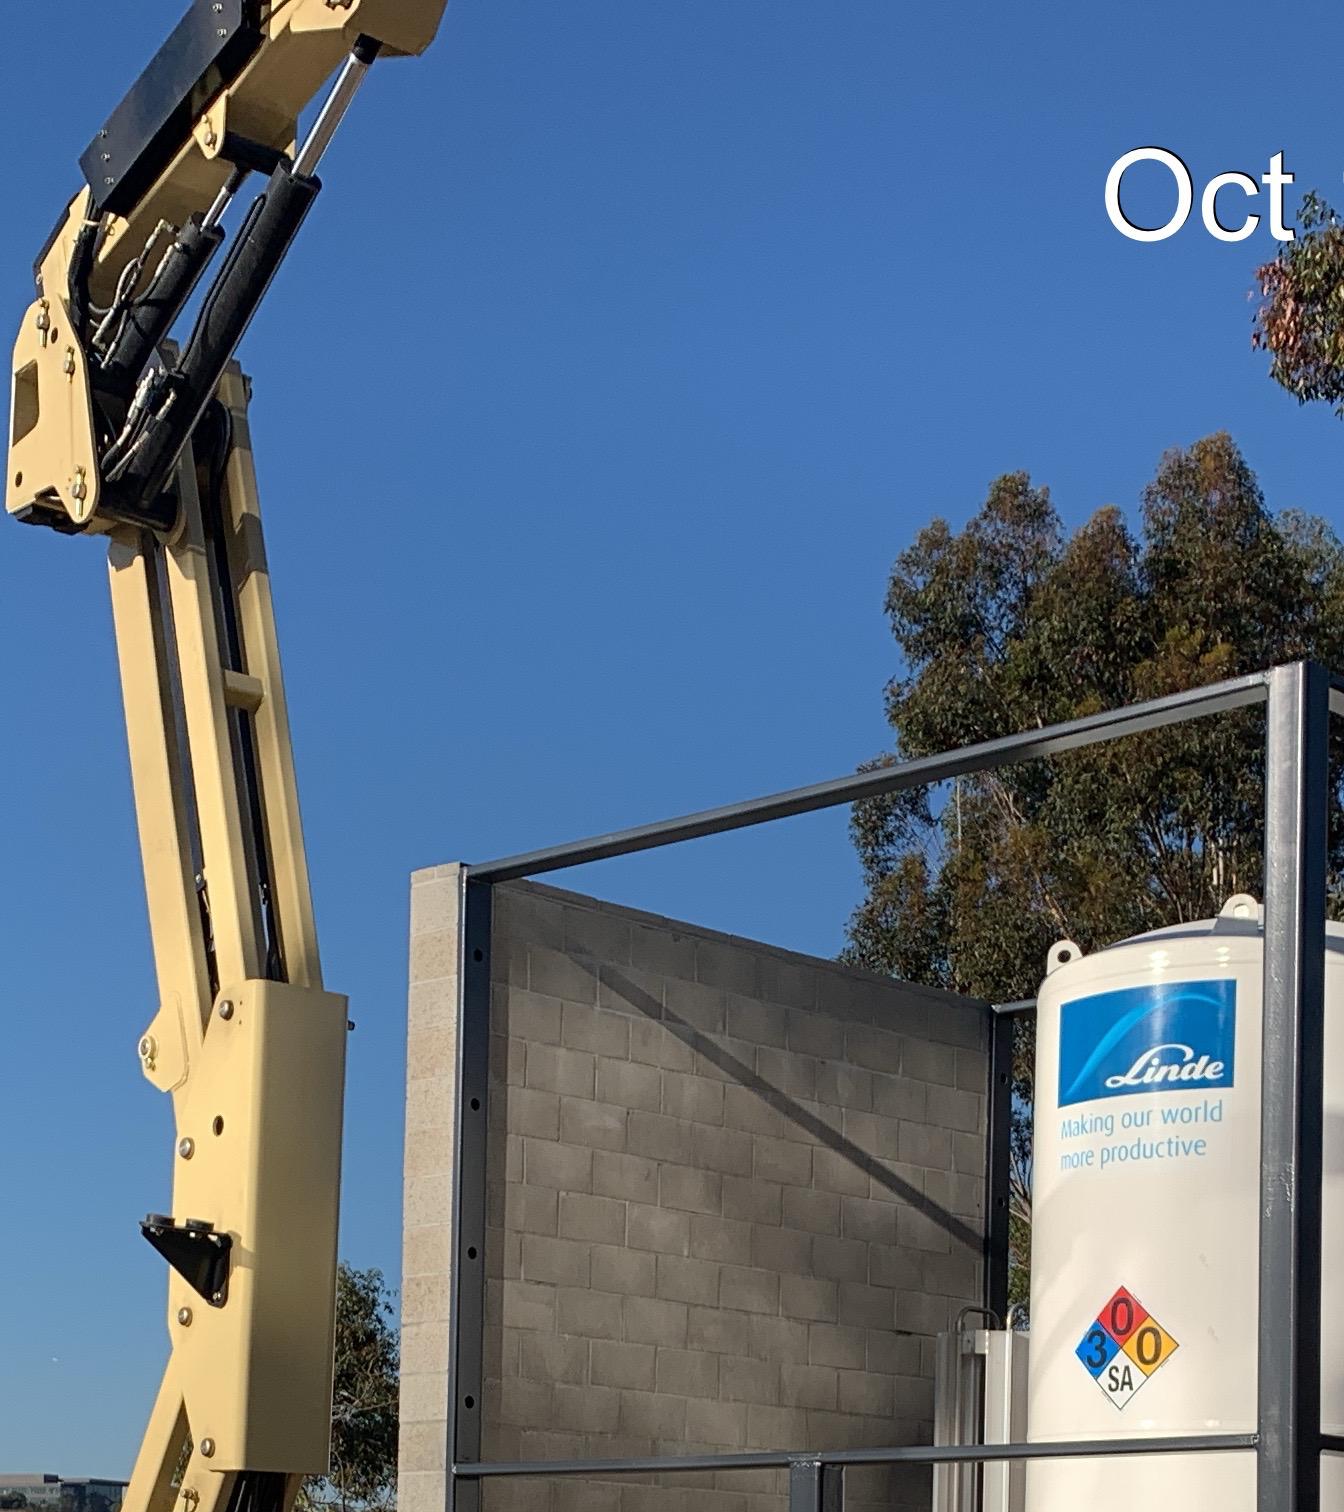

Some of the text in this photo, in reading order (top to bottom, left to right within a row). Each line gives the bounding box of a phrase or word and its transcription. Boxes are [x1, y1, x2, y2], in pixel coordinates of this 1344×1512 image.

[1105, 1043, 1224, 1088] Linde
[1061, 1099, 1222, 1139] Making our world
[1060, 1136, 1207, 1170] more productive
[1111, 1297, 1134, 1336] 0
[1086, 1326, 1162, 1368] 3 0
[1107, 1364, 1134, 1392] SA
